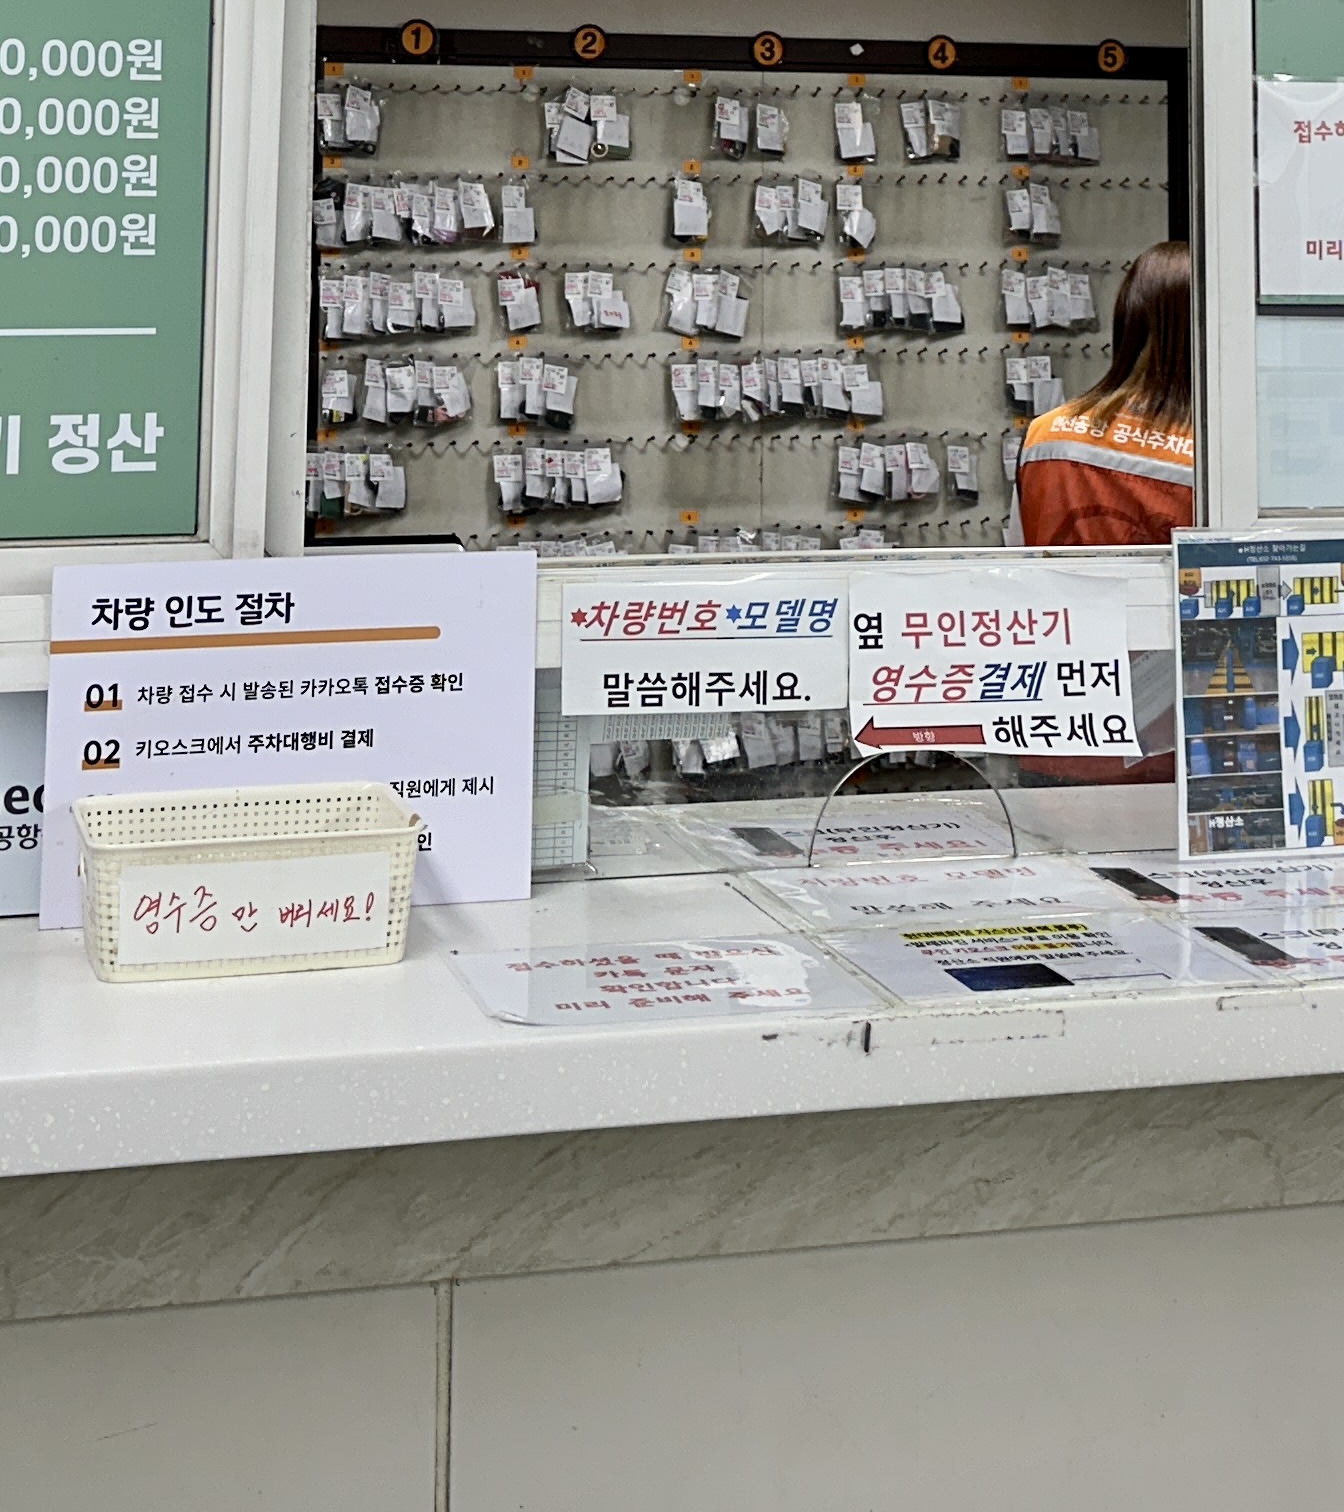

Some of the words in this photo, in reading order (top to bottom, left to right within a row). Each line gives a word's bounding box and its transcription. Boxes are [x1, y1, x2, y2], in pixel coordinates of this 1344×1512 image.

[411, 28, 422, 50] 1
[581, 31, 596, 54] 2
[760, 38, 775, 61] 3
[932, 42, 948, 64] 4
[1103, 46, 1118, 68] 5
[1306, 239, 1343, 261] 미리
[47, 411, 165, 474] 정산
[90, 596, 156, 632] 차량
[165, 594, 225, 628] 인도
[235, 591, 296, 626] 절차
[586, 599, 722, 637] 차량번호
[739, 597, 837, 636] 모델명
[854, 612, 884, 650] 옆
[900, 608, 1073, 649] 무인정산기
[84, 682, 121, 709] 01
[137, 684, 173, 706] 차량
[179, 682, 214, 704] 접수
[219, 681, 237, 703] 시
[242, 678, 294, 702] 발송된
[300, 675, 369, 699] 카카오톡
[374, 674, 425, 697] 접수증
[430, 672, 464, 694] 확인
[603, 670, 811, 708] 말씀해주세요.
[1056, 660, 1122, 699] 먼저
[83, 739, 120, 766] 02
[135, 732, 242, 759] 키오스크에서
[247, 729, 334, 755] 주차대행비
[340, 728, 375, 750] 결제
[991, 711, 1136, 749] 해주세요
[462, 775, 494, 796] 제시
[133, 884, 218, 934] 영수증
[278, 891, 375, 927] 버리세요!
